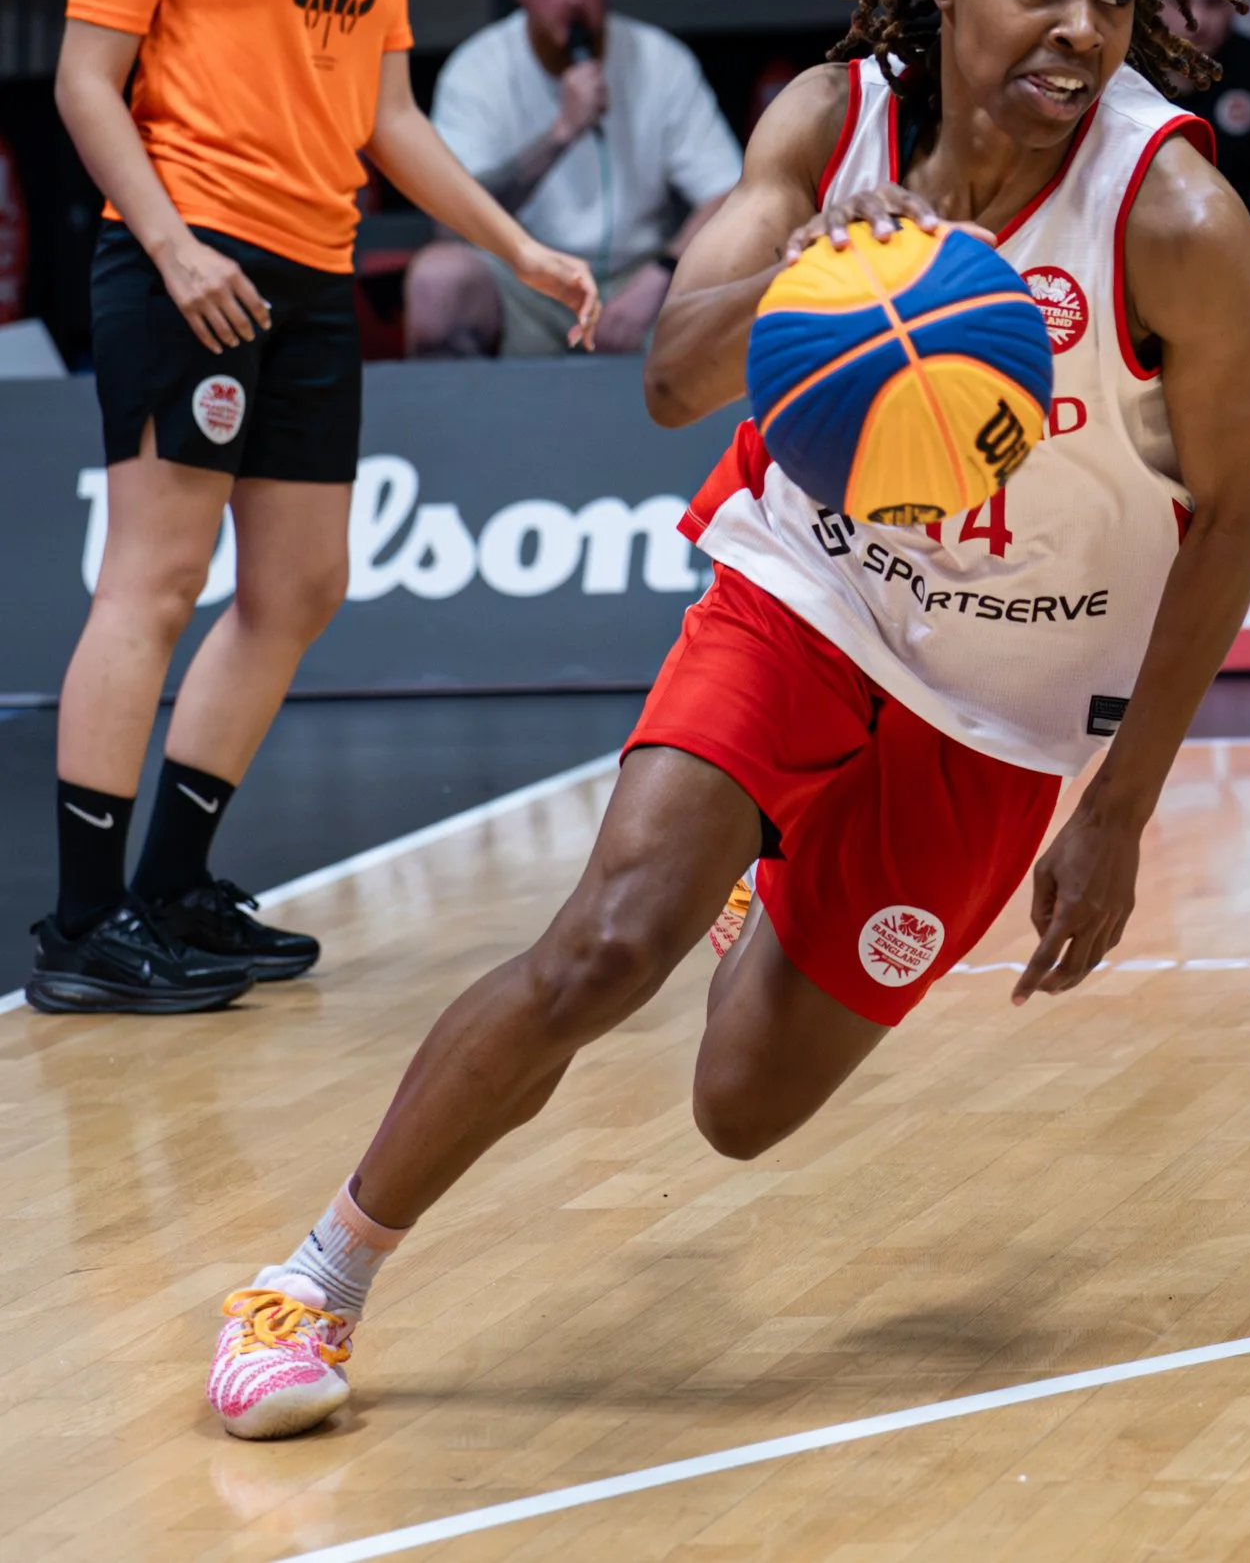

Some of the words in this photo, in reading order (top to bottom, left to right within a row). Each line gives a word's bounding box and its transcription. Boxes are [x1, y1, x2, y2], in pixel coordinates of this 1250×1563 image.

[862, 542, 1109, 624] SPORTSERVE
[872, 923, 932, 961] BASKETBALL
[875, 936, 921, 967] ENGLAND
